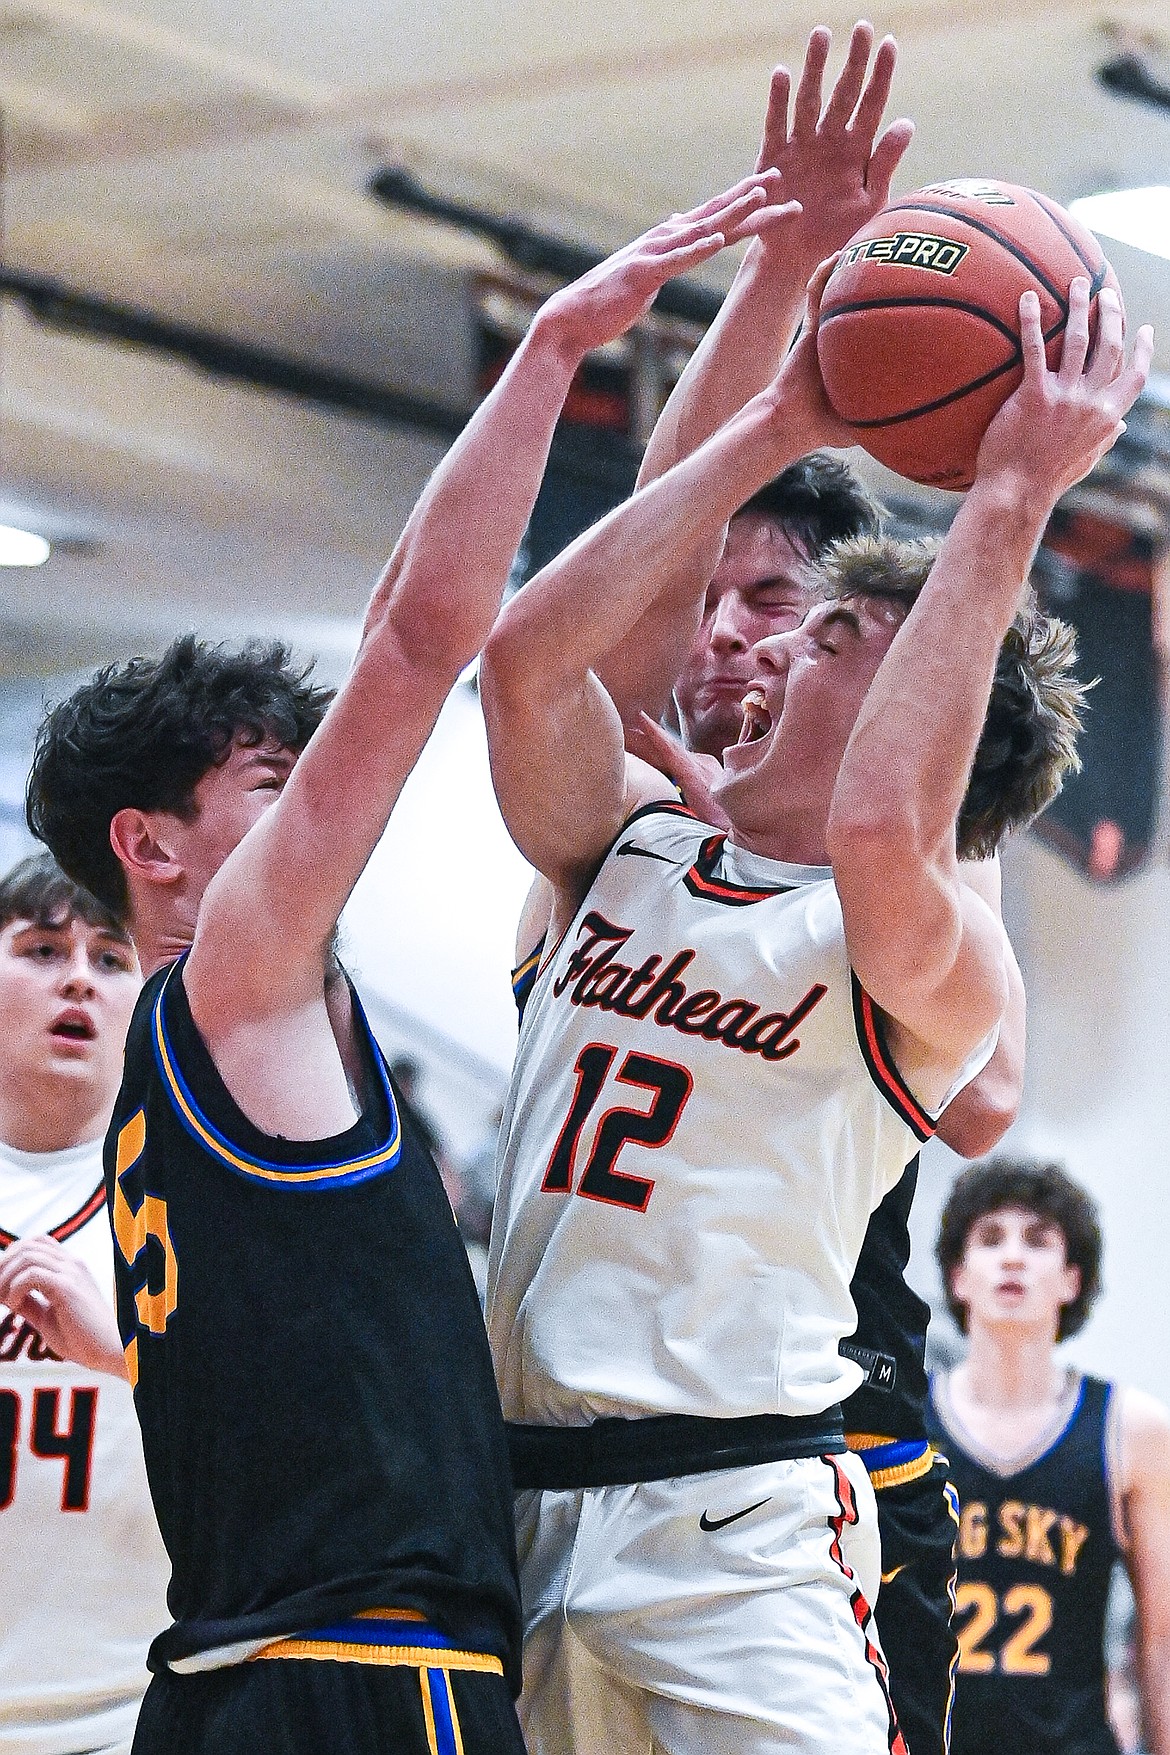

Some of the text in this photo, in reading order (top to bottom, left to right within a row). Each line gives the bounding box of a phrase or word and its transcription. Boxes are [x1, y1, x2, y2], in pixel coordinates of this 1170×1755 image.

[552, 910, 829, 1062] Flathead
[540, 1041, 695, 1214] 12
[878, 1364, 892, 1383] M
[997, 1499, 1090, 1577] SKY
[954, 1580, 1054, 1675] 22
